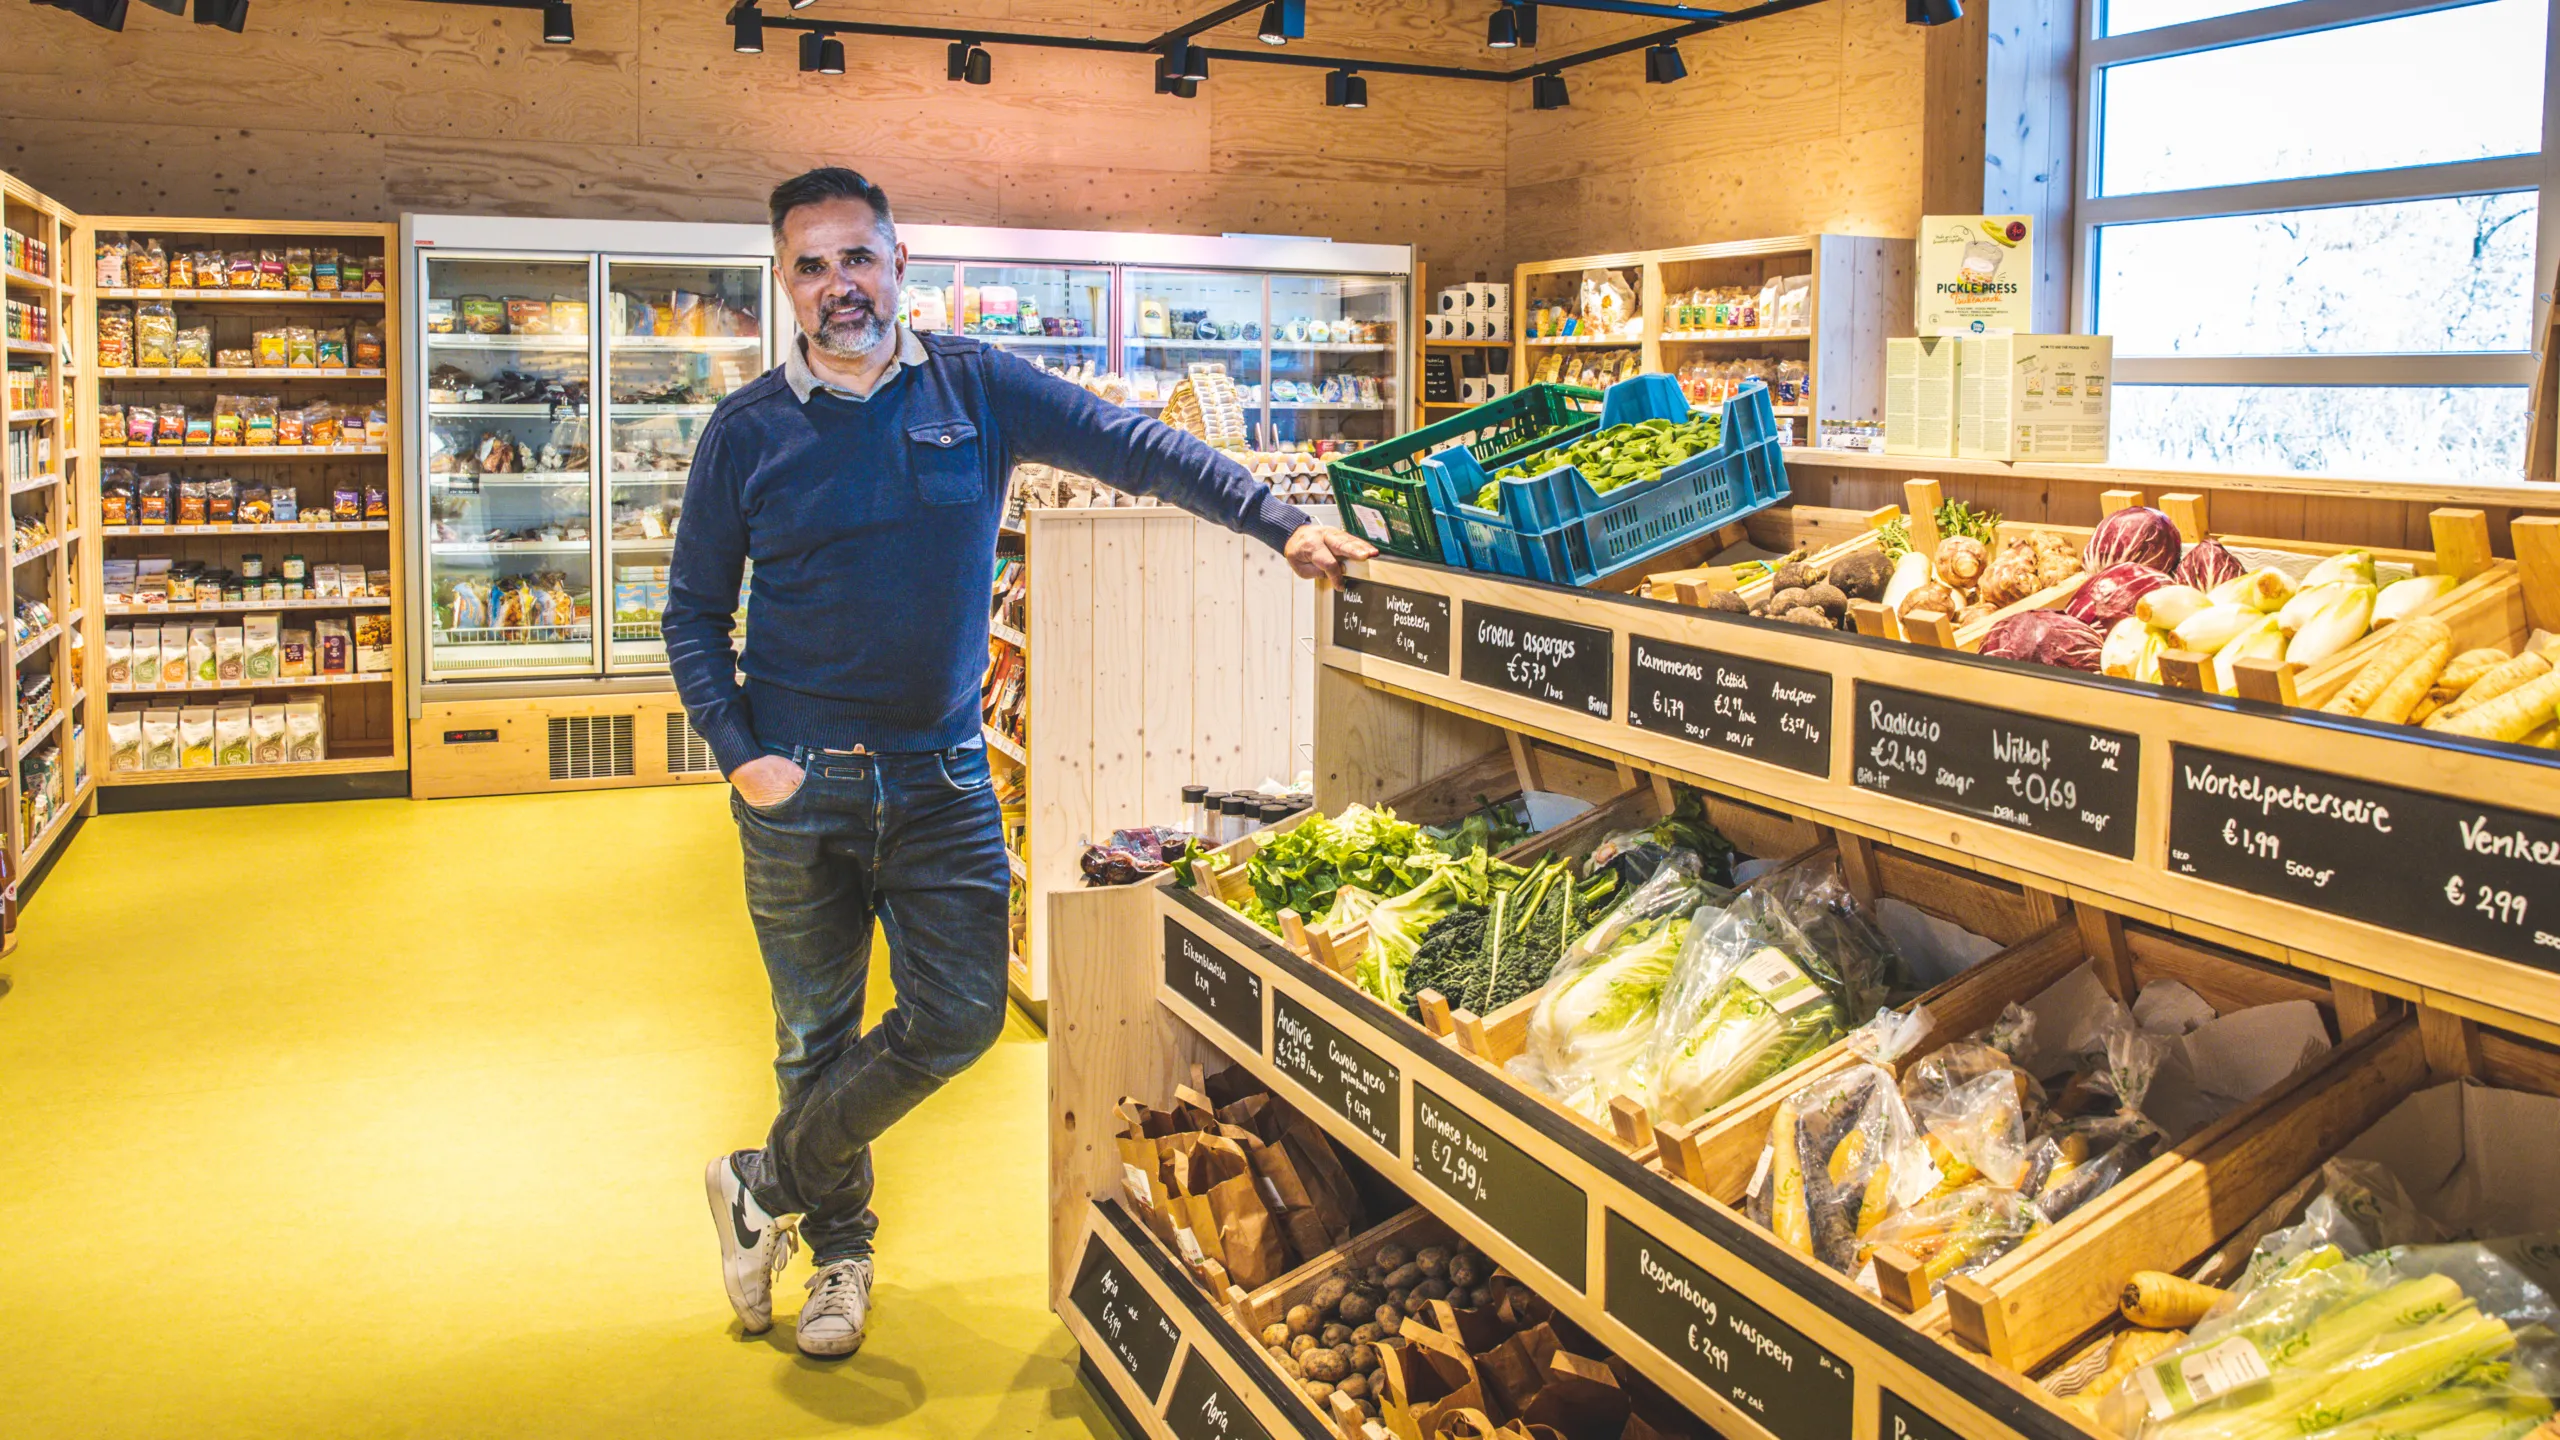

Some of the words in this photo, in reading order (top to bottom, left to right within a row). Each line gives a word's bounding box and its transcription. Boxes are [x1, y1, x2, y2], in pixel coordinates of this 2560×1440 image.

[1937, 283, 1978, 294] PICKLE
[1982, 283, 2018, 294] PRESS
[1386, 595, 1413, 614] Winter
[1478, 620, 1515, 648] Groene
[1523, 632, 1575, 668] asperges
[1637, 646, 1703, 681] Rammenas
[1507, 653, 1546, 689] €5,79
[1716, 667, 1749, 690] Rettich
[1771, 682, 1816, 707] Aardpeer
[1869, 700, 1940, 742] Radiccio
[1870, 737, 1927, 775] €2,49
[1993, 729, 2050, 771] Witlof
[2006, 769, 2077, 811] €0,69
[2185, 764, 2392, 833] Wortelpeterselie
[1328, 1039, 1357, 1073] Cavolo
[1363, 1069, 1386, 1094] nero
[1420, 1102, 1461, 1146] Chinese
[1100, 1269, 1119, 1298] Agria
[1640, 1248, 1718, 1326] Regenboog
[1729, 1315, 1793, 1372] waspeen
[1201, 1391, 1229, 1434] Agria
